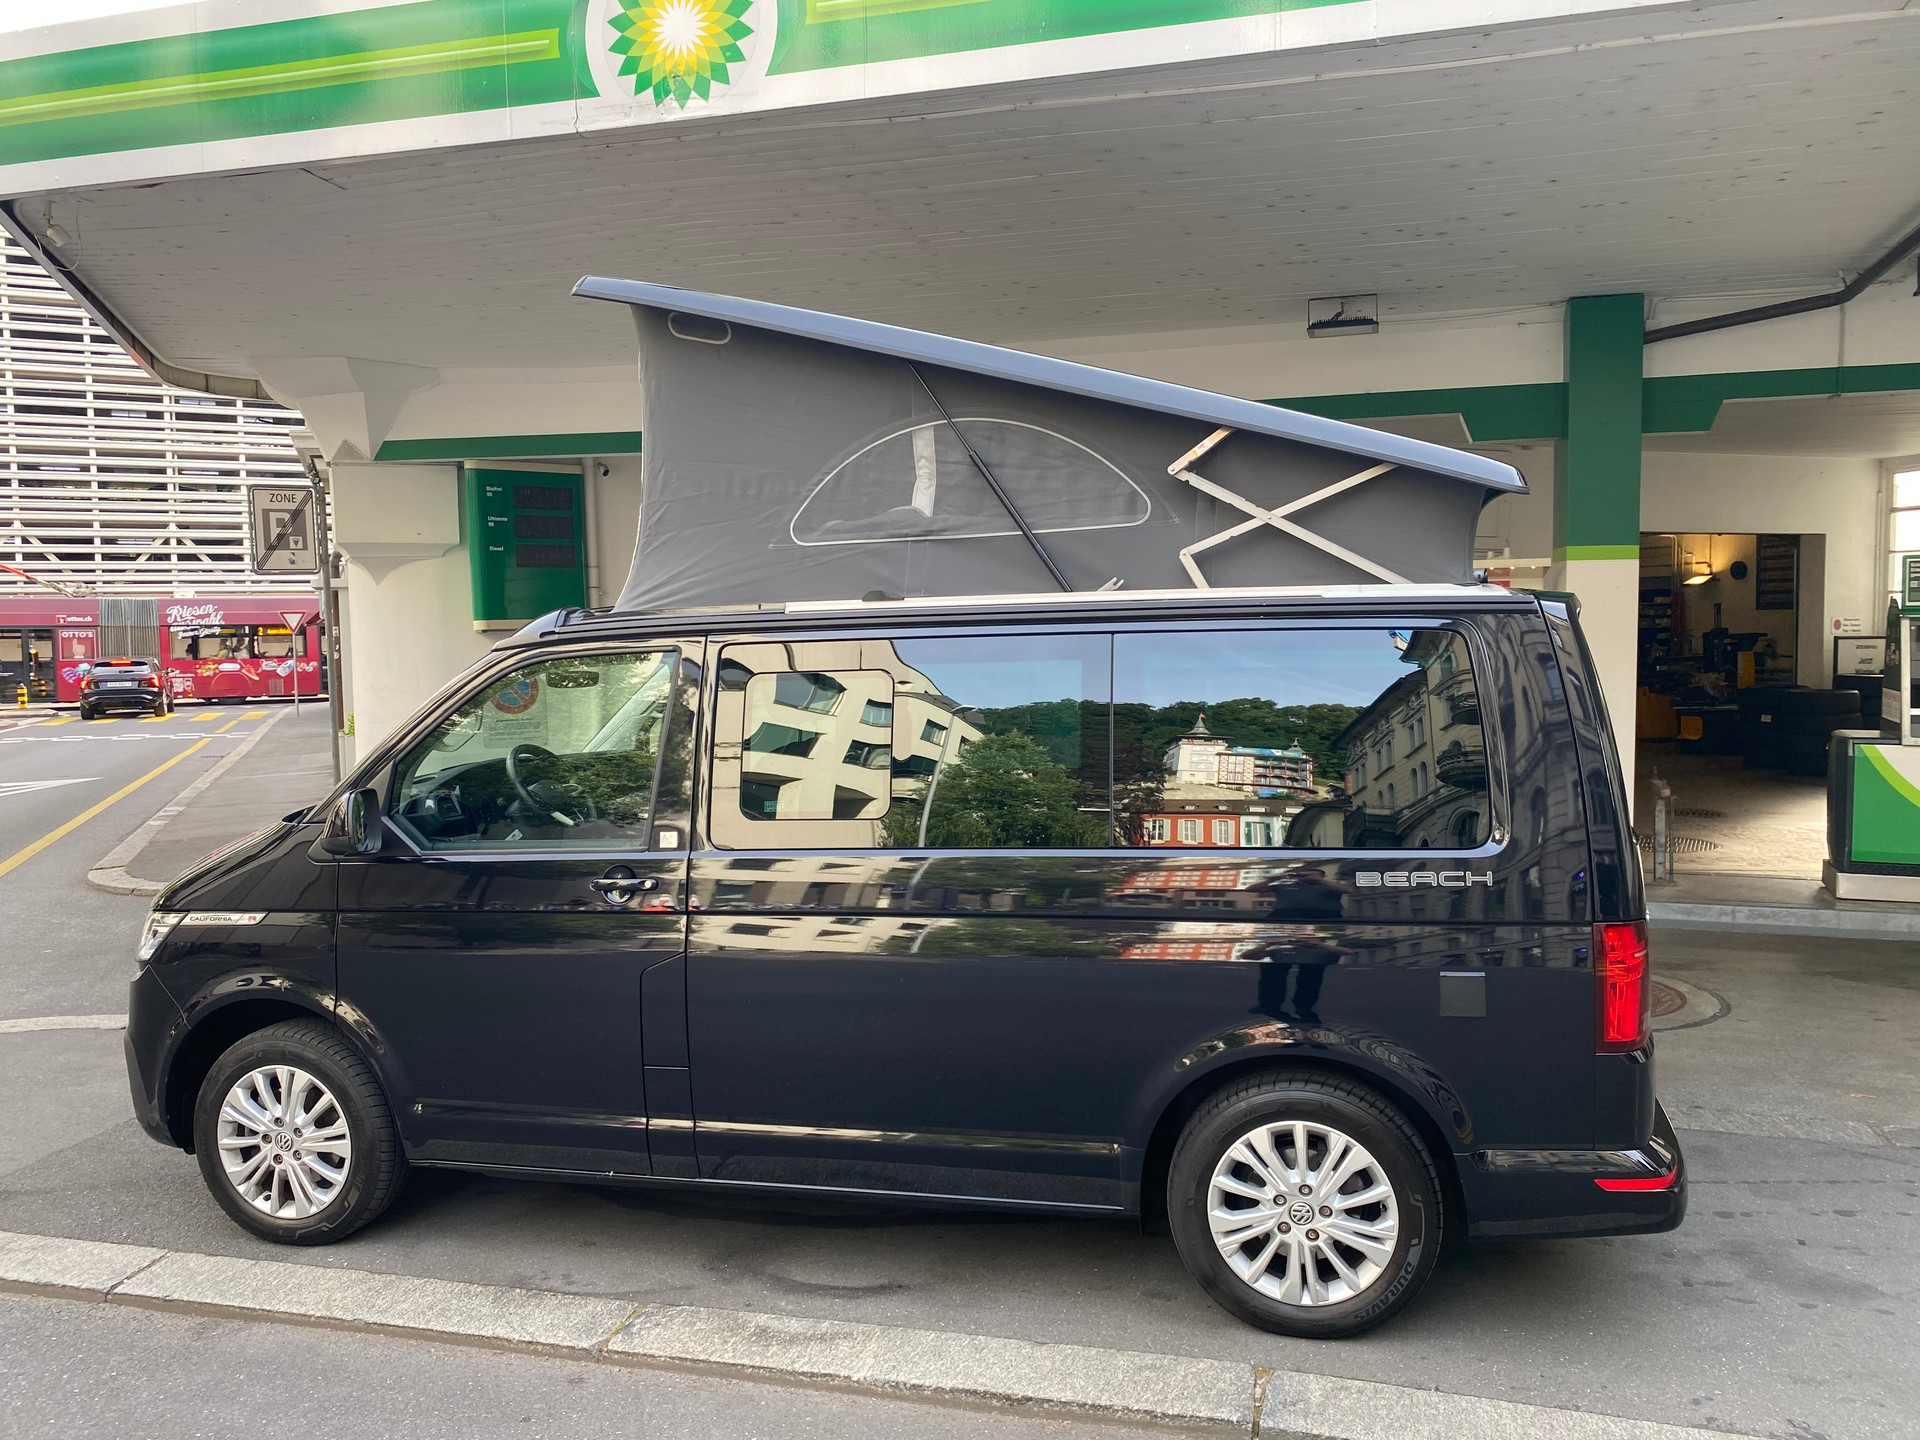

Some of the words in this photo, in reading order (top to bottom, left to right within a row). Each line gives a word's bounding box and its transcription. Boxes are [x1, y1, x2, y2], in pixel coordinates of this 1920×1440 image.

[269, 493, 297, 503] ZONE
[166, 604, 218, 623] Riesen-
[258, 627, 264, 636] 2
[1355, 871, 1493, 887] BEACH
[1354, 1260, 1416, 1321] DURAVIS
